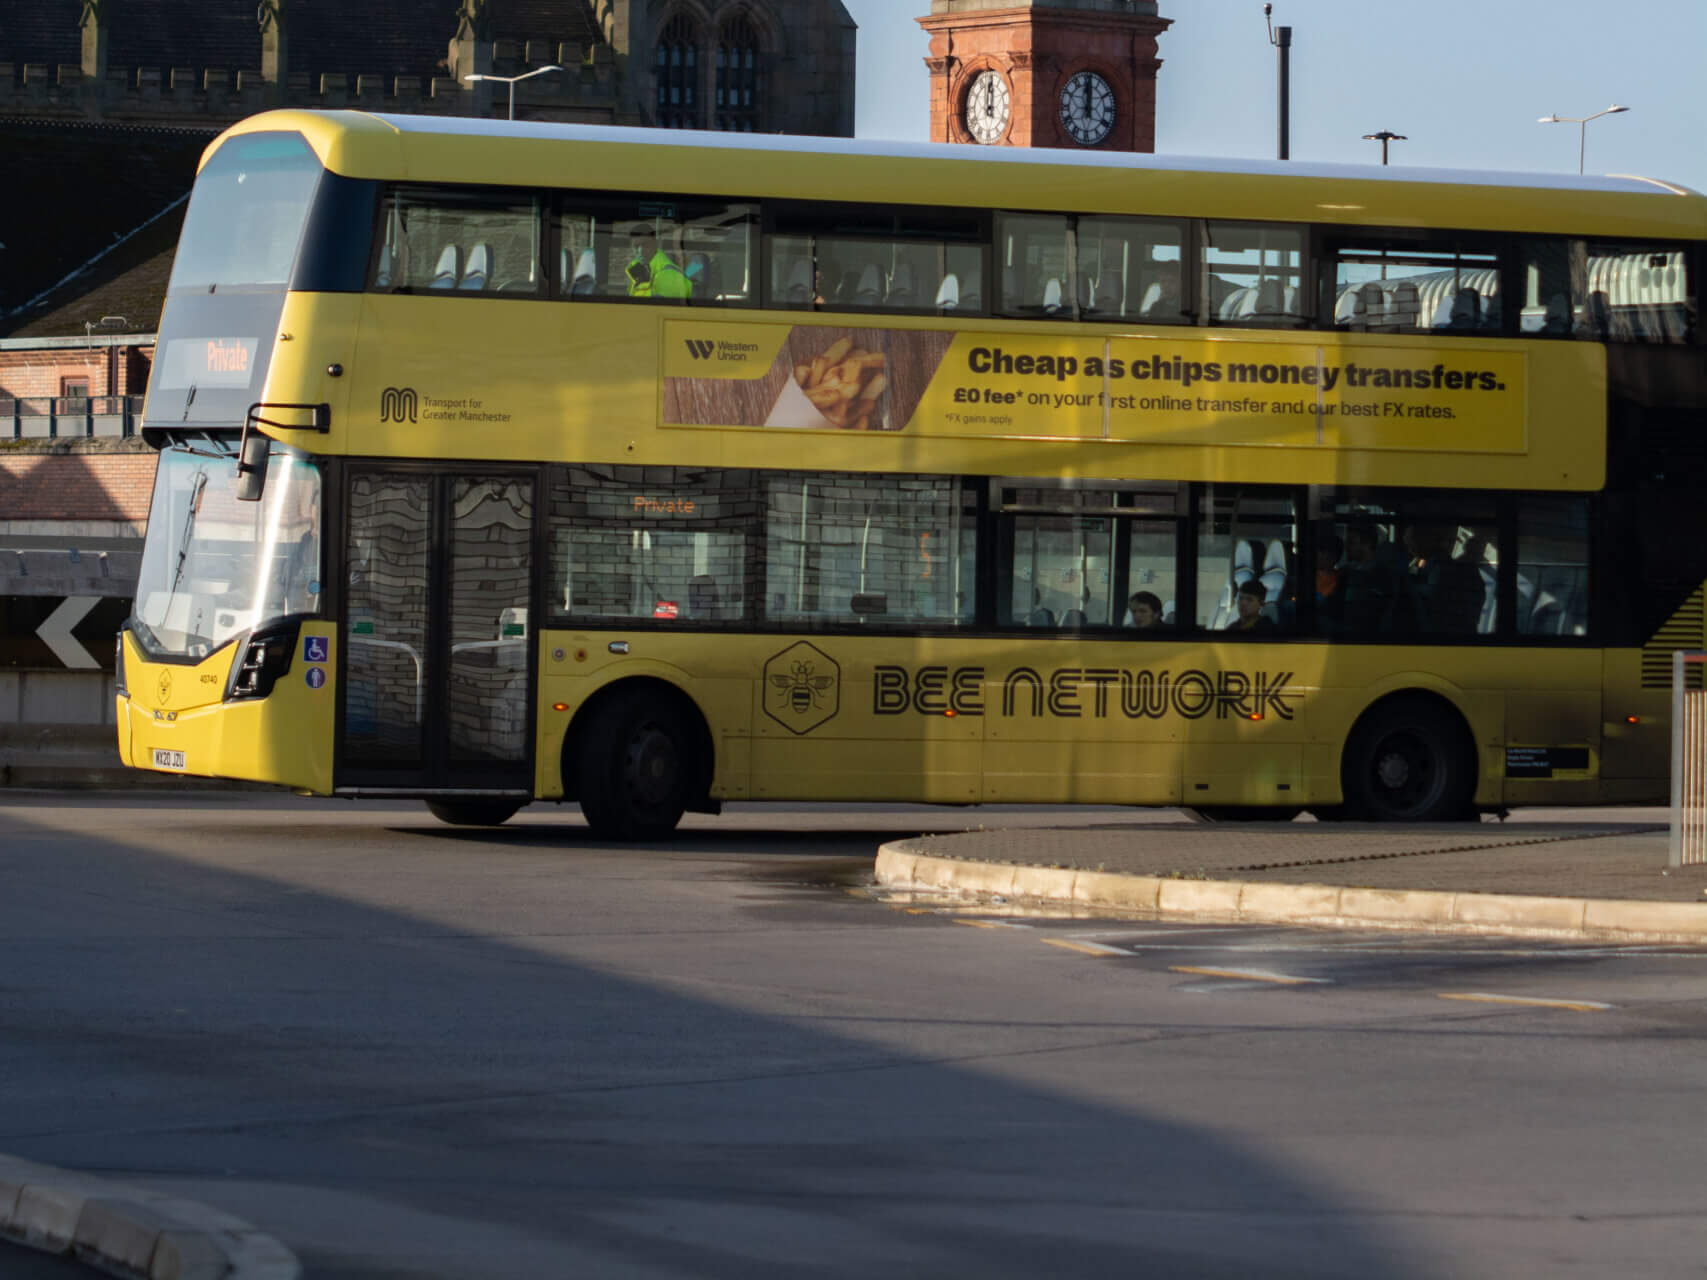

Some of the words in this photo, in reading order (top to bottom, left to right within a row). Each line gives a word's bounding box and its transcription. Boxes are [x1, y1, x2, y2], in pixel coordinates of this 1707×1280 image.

[717, 340, 758, 352] Western
[208, 339, 248, 371] Private
[717, 352, 748, 361] Union
[968, 347, 1077, 381] Cheap
[1084, 356, 1125, 379] as
[1131, 355, 1222, 387] chips
[1227, 363, 1339, 392] money
[1345, 362, 1506, 391] transfers.
[423, 396, 466, 409] Transport
[469, 398, 482, 409] for
[953, 388, 980, 403] £0
[1027, 392, 1050, 405] on
[1054, 392, 1094, 408] your
[1139, 395, 1192, 411] online
[1197, 396, 1267, 413] transfer
[1271, 399, 1304, 414] and
[1308, 402, 1337, 416] our
[1341, 401, 1379, 417] best
[1383, 402, 1404, 417] FX
[1407, 403, 1457, 420] rates.
[422, 409, 457, 421] Greater
[459, 410, 512, 423] Manchester
[963, 415, 987, 425] gains
[989, 415, 1012, 426] apply
[633, 496, 696, 513] Private
[873, 665, 985, 717] BEE
[1002, 666, 1294, 721] NETWORK
